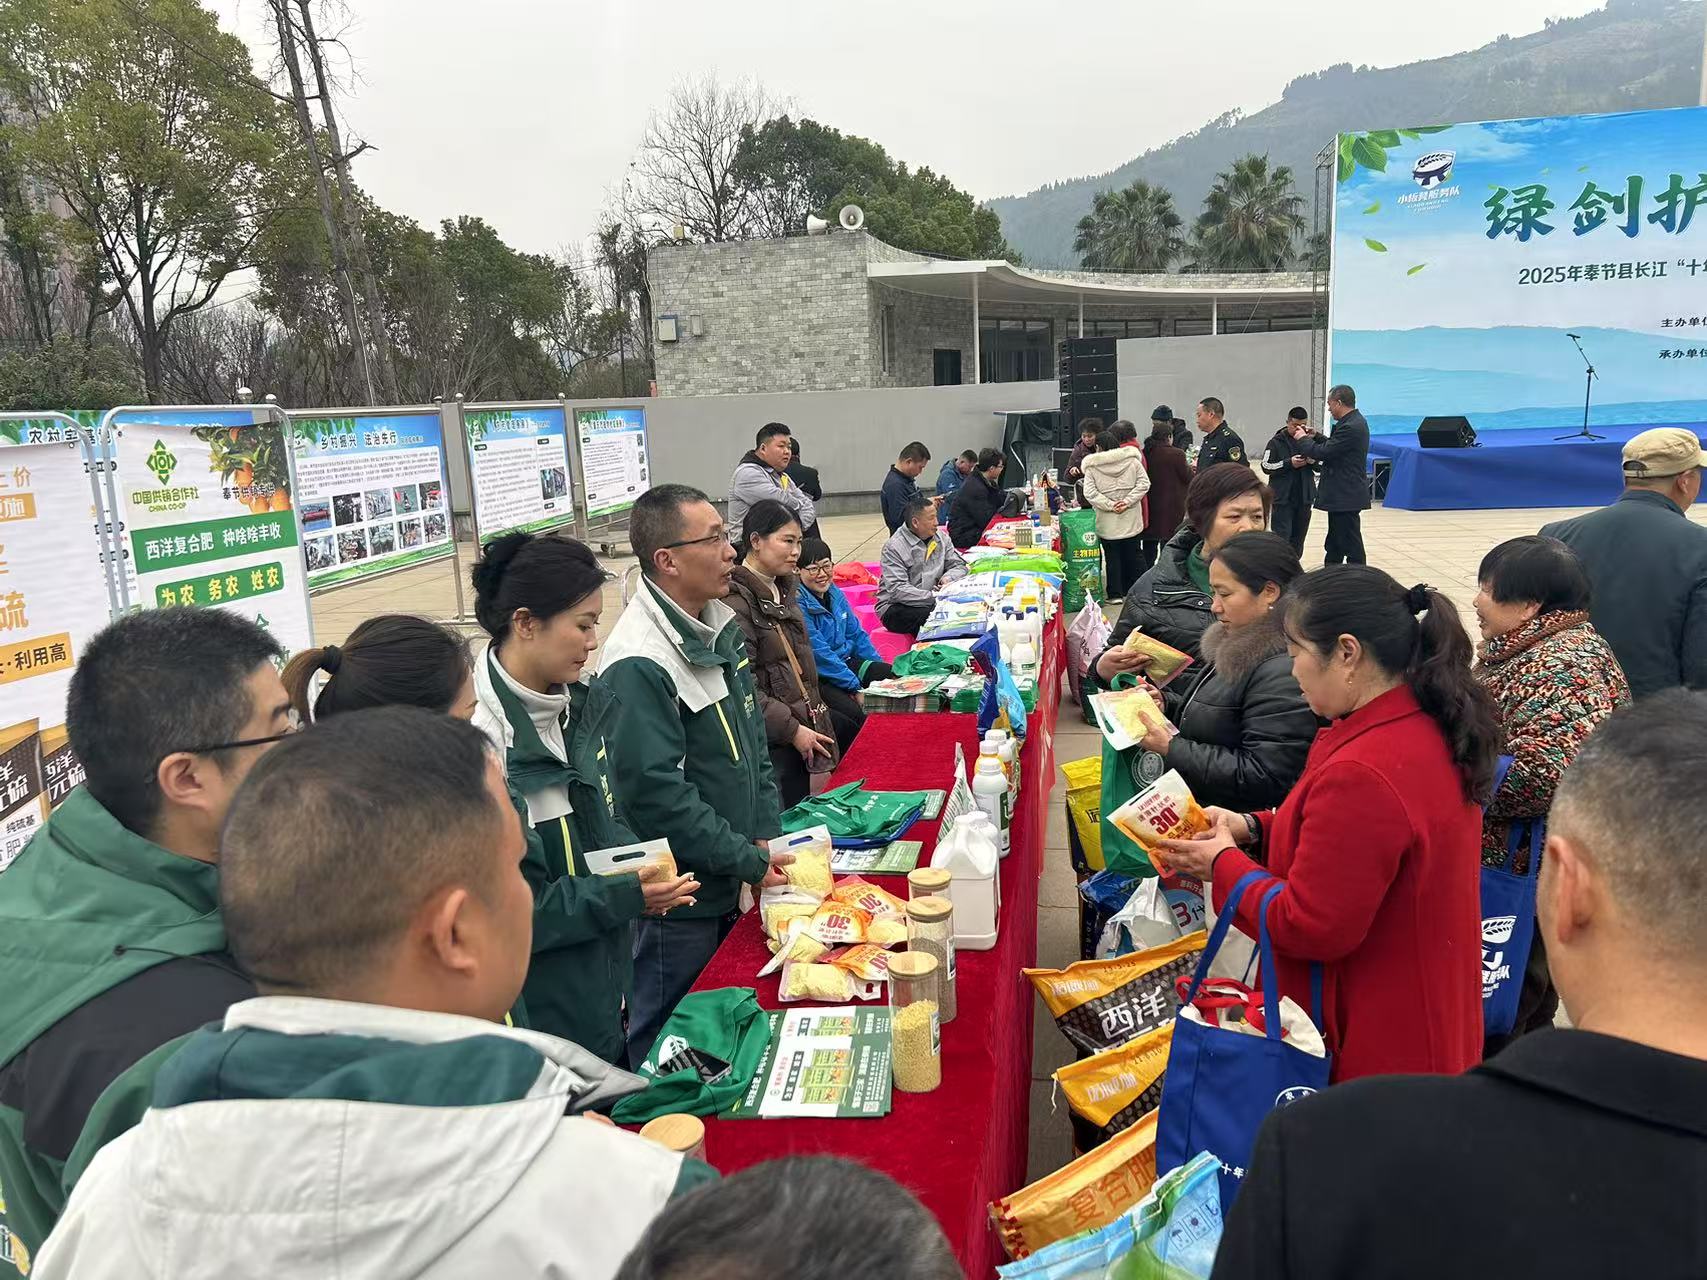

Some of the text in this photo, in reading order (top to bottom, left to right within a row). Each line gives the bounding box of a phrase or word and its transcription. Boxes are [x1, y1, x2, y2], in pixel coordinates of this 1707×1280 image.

[321, 434, 357, 450] 乡村振兴
[364, 431, 397, 446] 法治先行
[132, 486, 199, 505] 中国供销合作社
[149, 505, 167, 513] CHINA
[145, 521, 281, 560] 西洋复合肥 种啥啥丰收
[161, 567, 280, 608] 为农 务农 姓农
[1098, 985, 1167, 1040] 西洋
[1221, 1163, 1249, 1179] 十年
